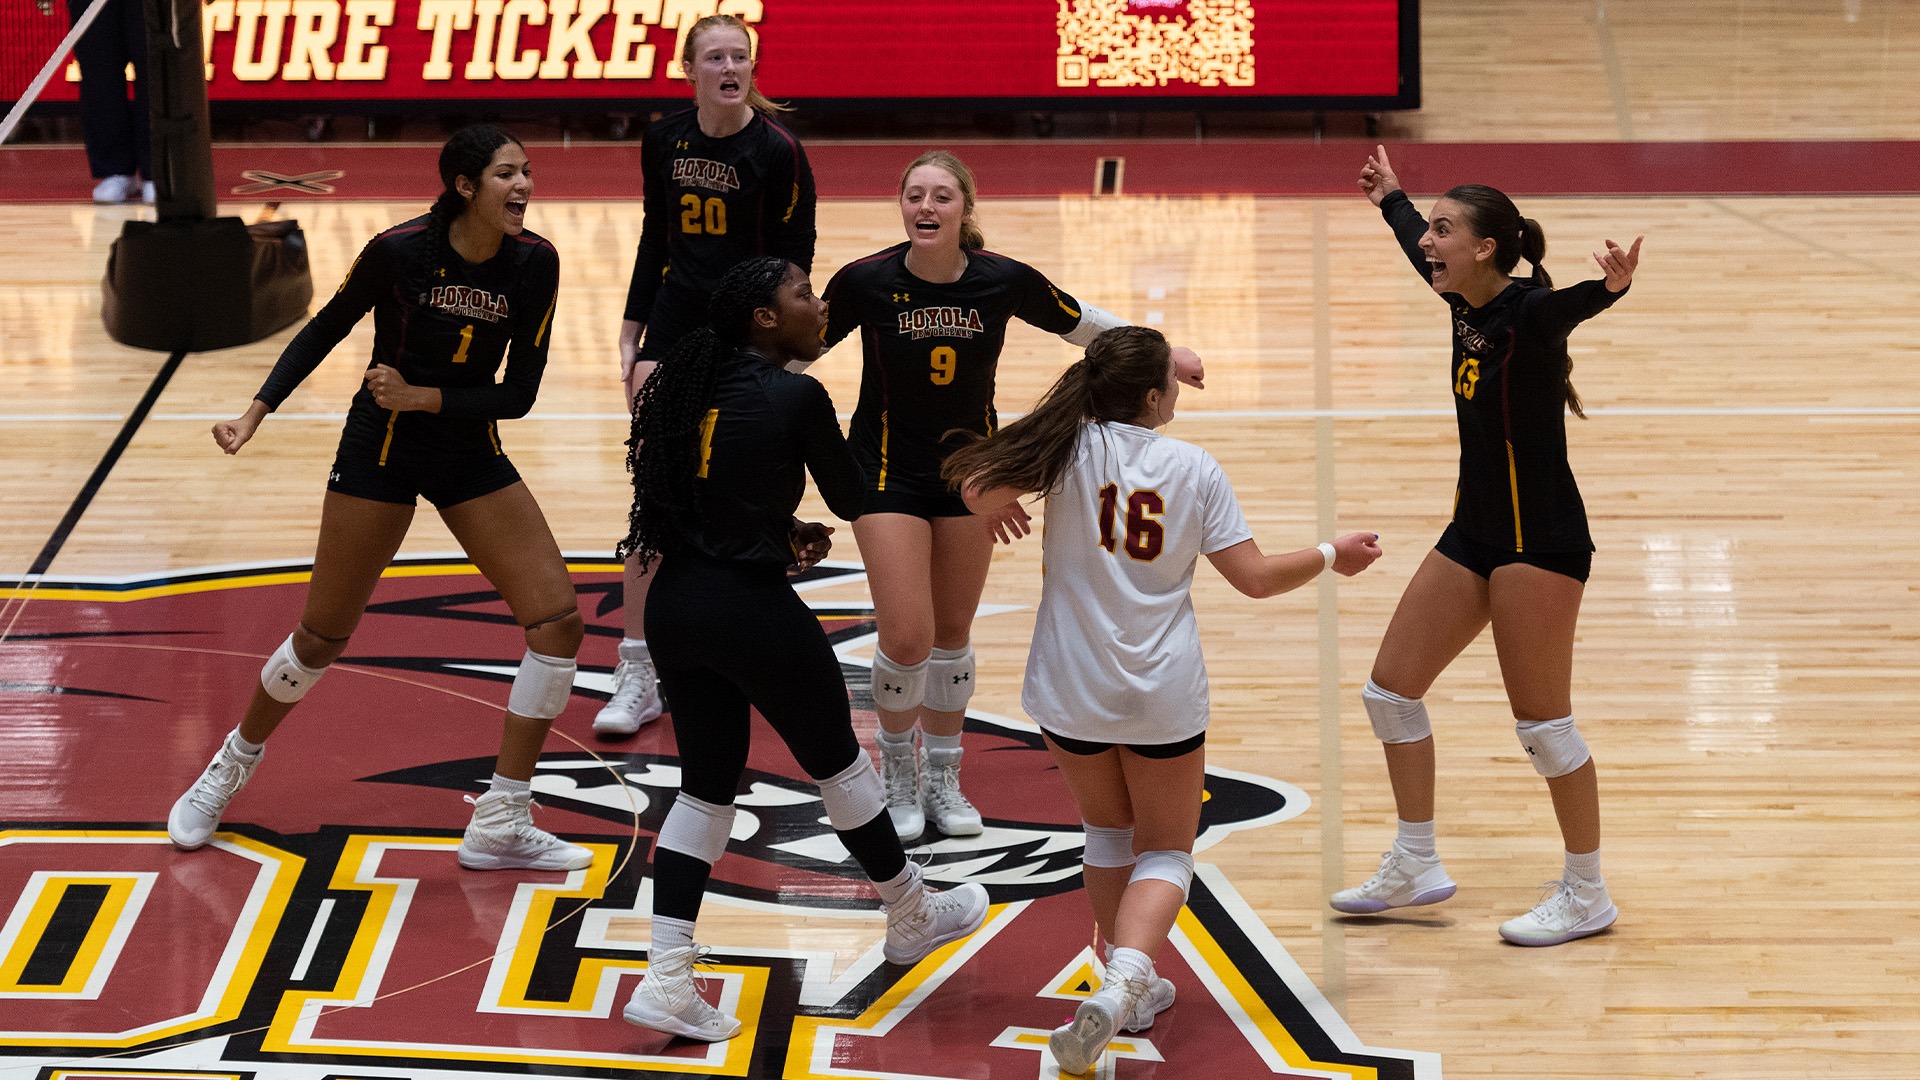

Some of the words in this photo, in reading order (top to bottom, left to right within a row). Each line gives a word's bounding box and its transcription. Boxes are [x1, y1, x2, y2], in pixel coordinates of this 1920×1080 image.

[65, 0, 391, 82] TURE
[672, 157, 740, 190] LOYOLA
[680, 193, 728, 236] 20
[429, 285, 509, 319] LOYOLA
[898, 306, 984, 335] LOYOLA
[451, 324, 474, 363] 1
[911, 327, 931, 341] NEW
[932, 326, 974, 340] ORLEANS
[930, 345, 957, 386] 9
[1097, 480, 1166, 564] 16
